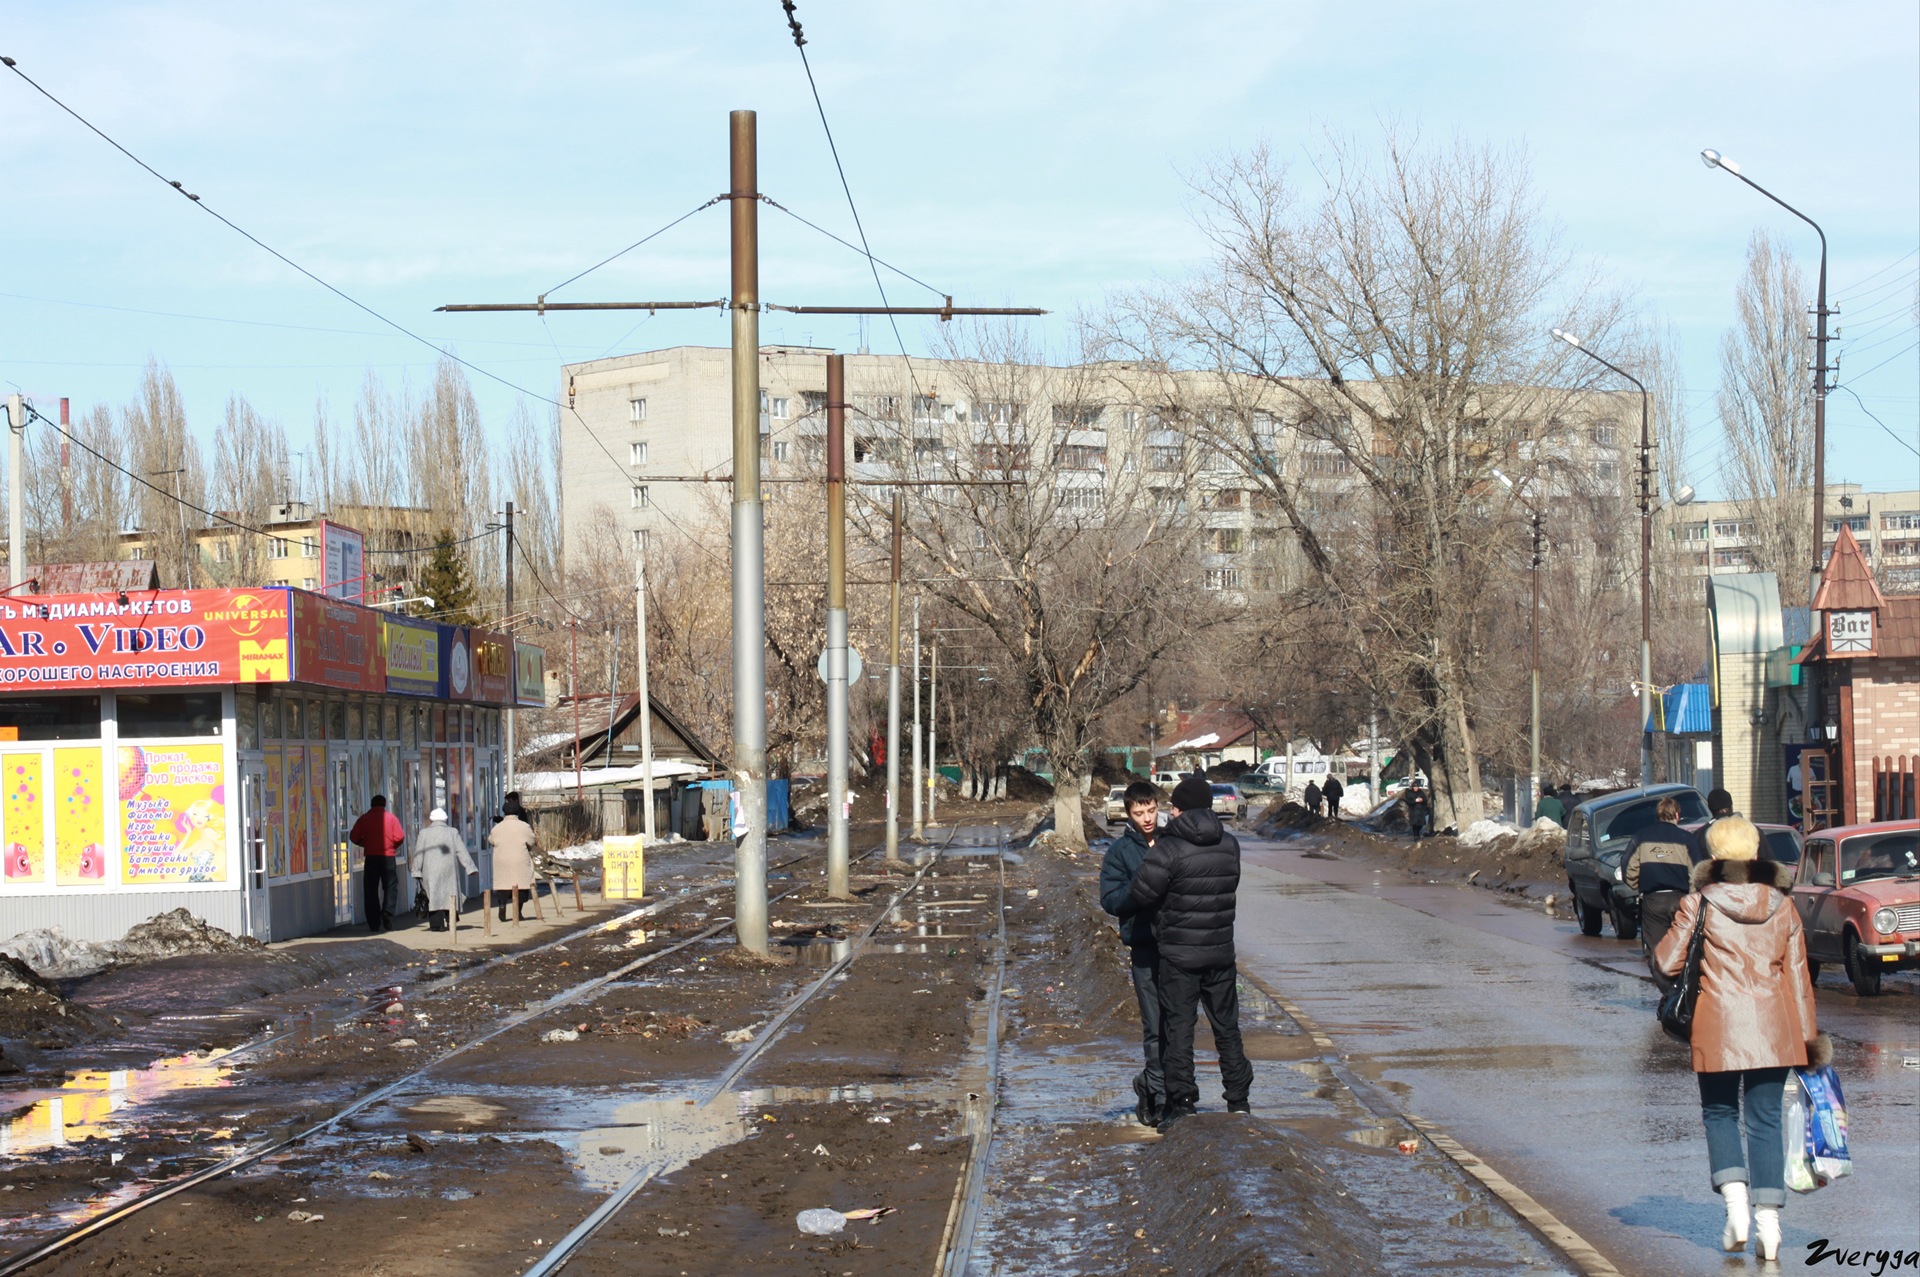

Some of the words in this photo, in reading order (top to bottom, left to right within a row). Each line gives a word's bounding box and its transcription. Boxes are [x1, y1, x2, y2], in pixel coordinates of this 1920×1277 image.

[22, 599, 192, 620] МЕДИАМАРКЕТОВ
[204, 609, 287, 622] UNIVERSAL
[1831, 615, 1870, 638] Bar
[75, 623, 206, 656] VIDEO
[242, 652, 284, 662] MIRAMAX
[98, 661, 219, 680] НАСТРОЕНИЯ
[170, 763, 219, 773] продажа
[146, 773, 169, 785] DVD
[174, 774, 215, 785] дисков
[127, 800, 170, 810] Музыка
[127, 811, 172, 820] Фильмы
[128, 822, 155, 832] Игры
[128, 833, 171, 841] Флешки
[128, 843, 175, 854] Игрушки
[129, 854, 188, 864] Батарейки
[138, 866, 177, 875] многое
[178, 865, 217, 876] другое
